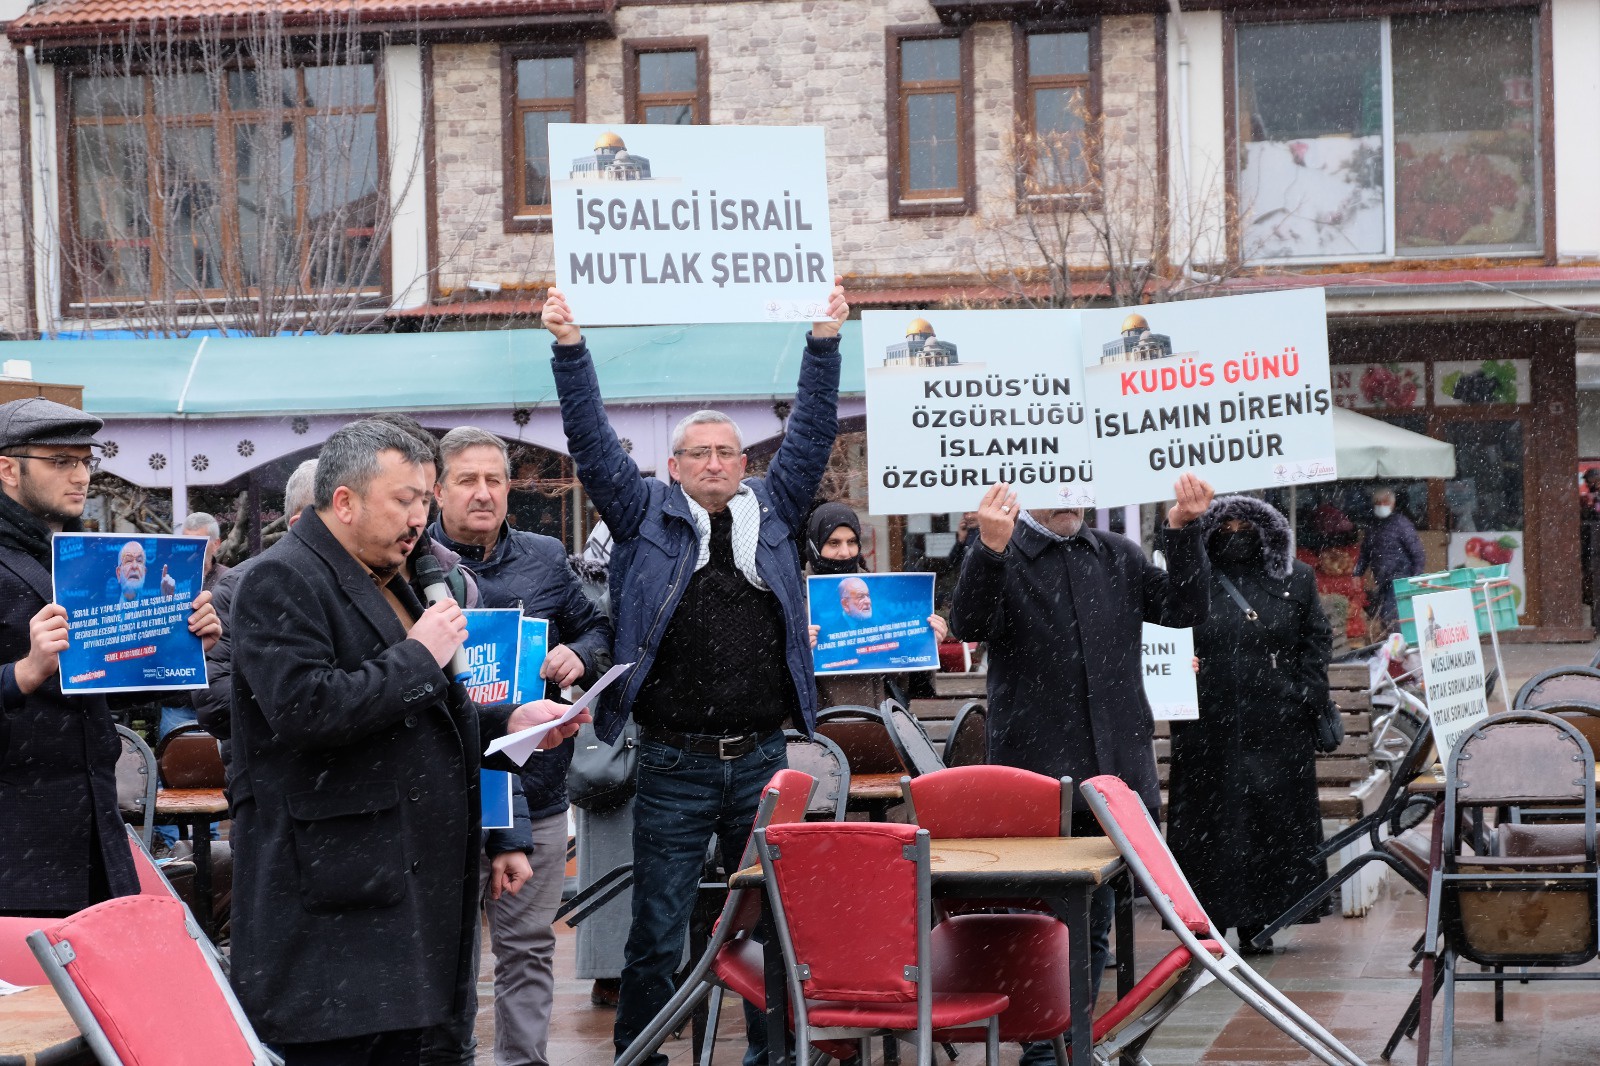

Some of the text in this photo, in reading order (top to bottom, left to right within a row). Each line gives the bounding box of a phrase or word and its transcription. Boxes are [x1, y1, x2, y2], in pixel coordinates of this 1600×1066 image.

[577, 188, 813, 235] İŞGALCİ İSRAİL
[569, 243, 827, 288] MUTLAK ŞERDİR
[1120, 346, 1299, 396] KUDÜS GÜNÜ
[912, 402, 1084, 428] ÖZGÜRLÜĞÜ
[1095, 383, 1331, 438] İSLAMIN DİRENİŞ
[940, 434, 1059, 457] İSLAMIN
[1149, 428, 1284, 472] GÜNÜDÜR
[882, 460, 1093, 489] ÖZGÜRLÜĞÜDÜ
[1141, 642, 1176, 655] RINI
[1431, 650, 1476, 674] MÜSLÜMANLARIN
[165, 668, 196, 677] SAADET
[1146, 663, 1171, 676] ME
[466, 680, 509, 703] ORUZ!
[1429, 674, 1483, 701] ORTAK SORUNLARINA
[1434, 698, 1485, 726] ORTAK SORUMLULUK
